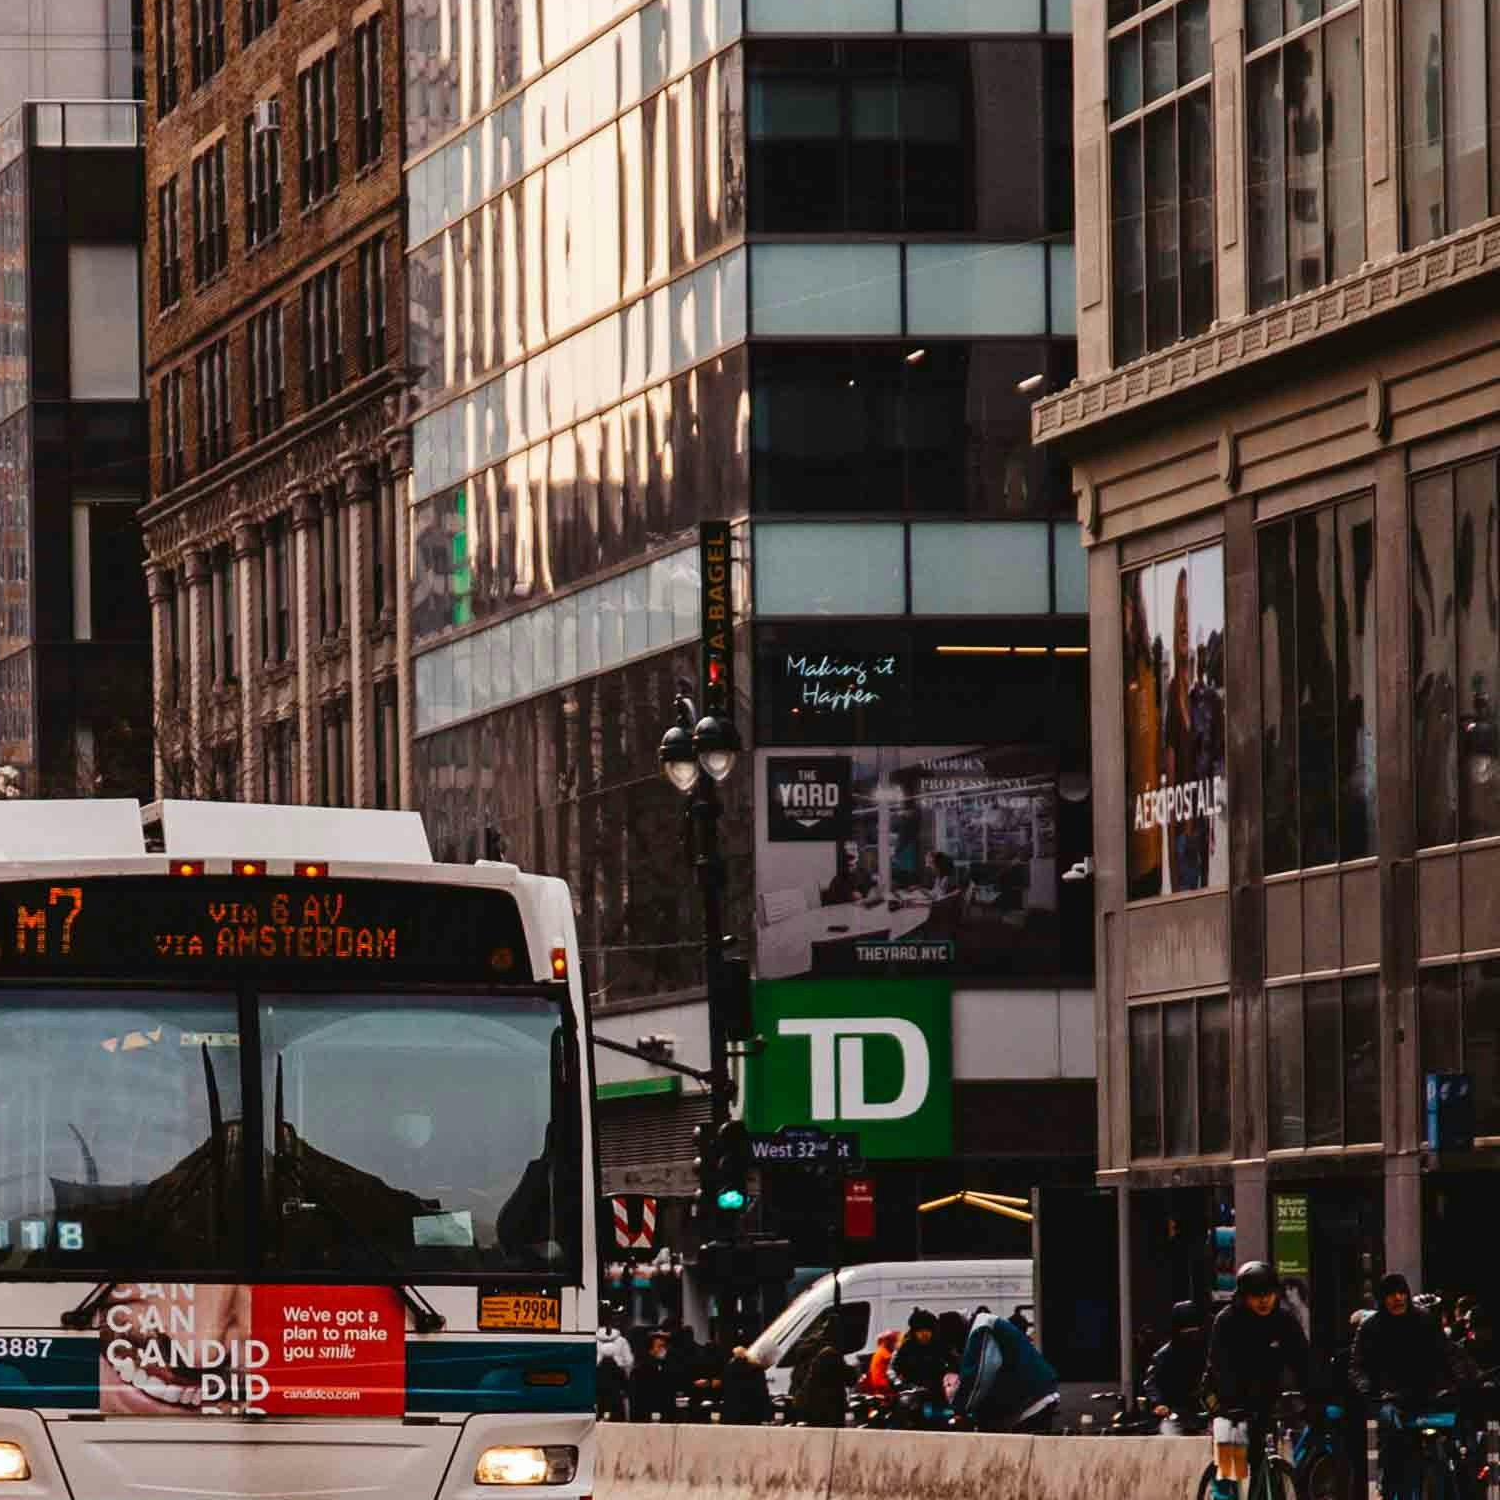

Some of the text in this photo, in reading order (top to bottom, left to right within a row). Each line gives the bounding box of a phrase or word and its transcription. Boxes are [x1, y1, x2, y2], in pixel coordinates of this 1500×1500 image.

[787, 655, 897, 684] Making it
[803, 683, 882, 711] Happen
[798, 769, 818, 781] THE
[779, 783, 839, 807] YARD
[15, 887, 83, 955] M7
[208, 901, 257, 924] VIA
[303, 893, 345, 924] AV
[155, 925, 398, 958] VIA AMSTERDAM
[778, 1017, 930, 1120] TD
[752, 1141, 792, 1157] West
[1278, 1206, 1308, 1217] NYC
[106, 1304, 196, 1334] CAN
[283, 1305, 379, 1326] We've got a
[283, 1326, 388, 1344] plan to make
[106, 1339, 270, 1369] CANDID
[283, 1345, 356, 1362] you smile
[201, 1373, 270, 1402] DID
[283, 1387, 361, 1401] candidco.com
